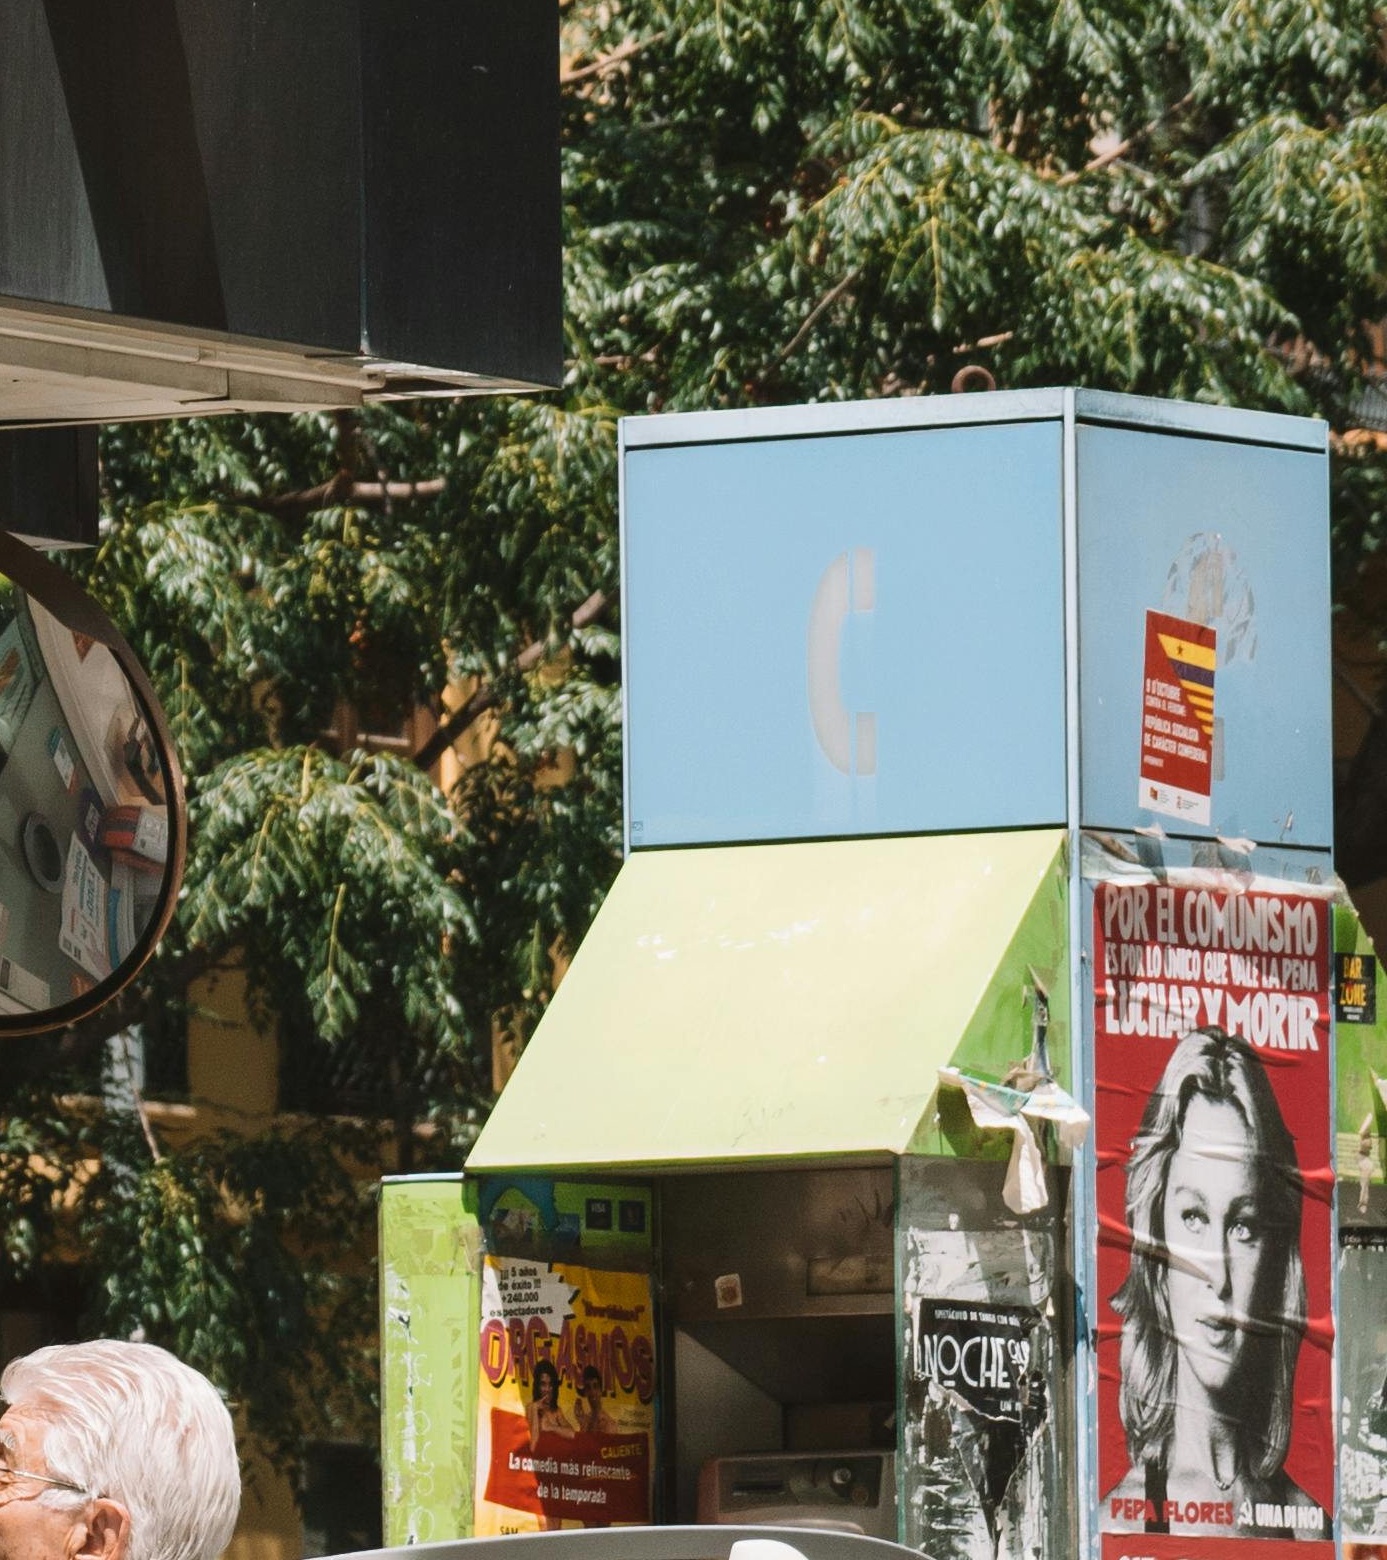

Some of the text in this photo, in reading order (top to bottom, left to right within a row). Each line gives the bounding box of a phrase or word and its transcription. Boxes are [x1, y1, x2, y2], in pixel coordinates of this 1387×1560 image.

[1104, 886, 1318, 957] POR EL COMUNISMO
[1105, 941, 1319, 993] ES POR LO ÚNICO QUE VALE LA PENA
[1342, 956, 1362, 979] BAR
[1339, 983, 1368, 1007] ZONE
[1105, 978, 1320, 1052] LUCHAR Y MORIR
[511, 1266, 538, 1277] 5 años
[498, 1279, 532, 1291] de éxito
[501, 1291, 540, 1303] +240.000
[489, 1305, 554, 1317] espectadores
[479, 1316, 656, 1405] ORGASMOS
[600, 1443, 643, 1459] CALIENTE
[509, 1452, 632, 1480] La comedia más refrescante
[537, 1483, 607, 1505] de la temporada
[1110, 1497, 1235, 1526] PEPA FLORES
[1255, 1503, 1283, 1528] UNA
[1296, 1505, 1324, 1530] NOI
